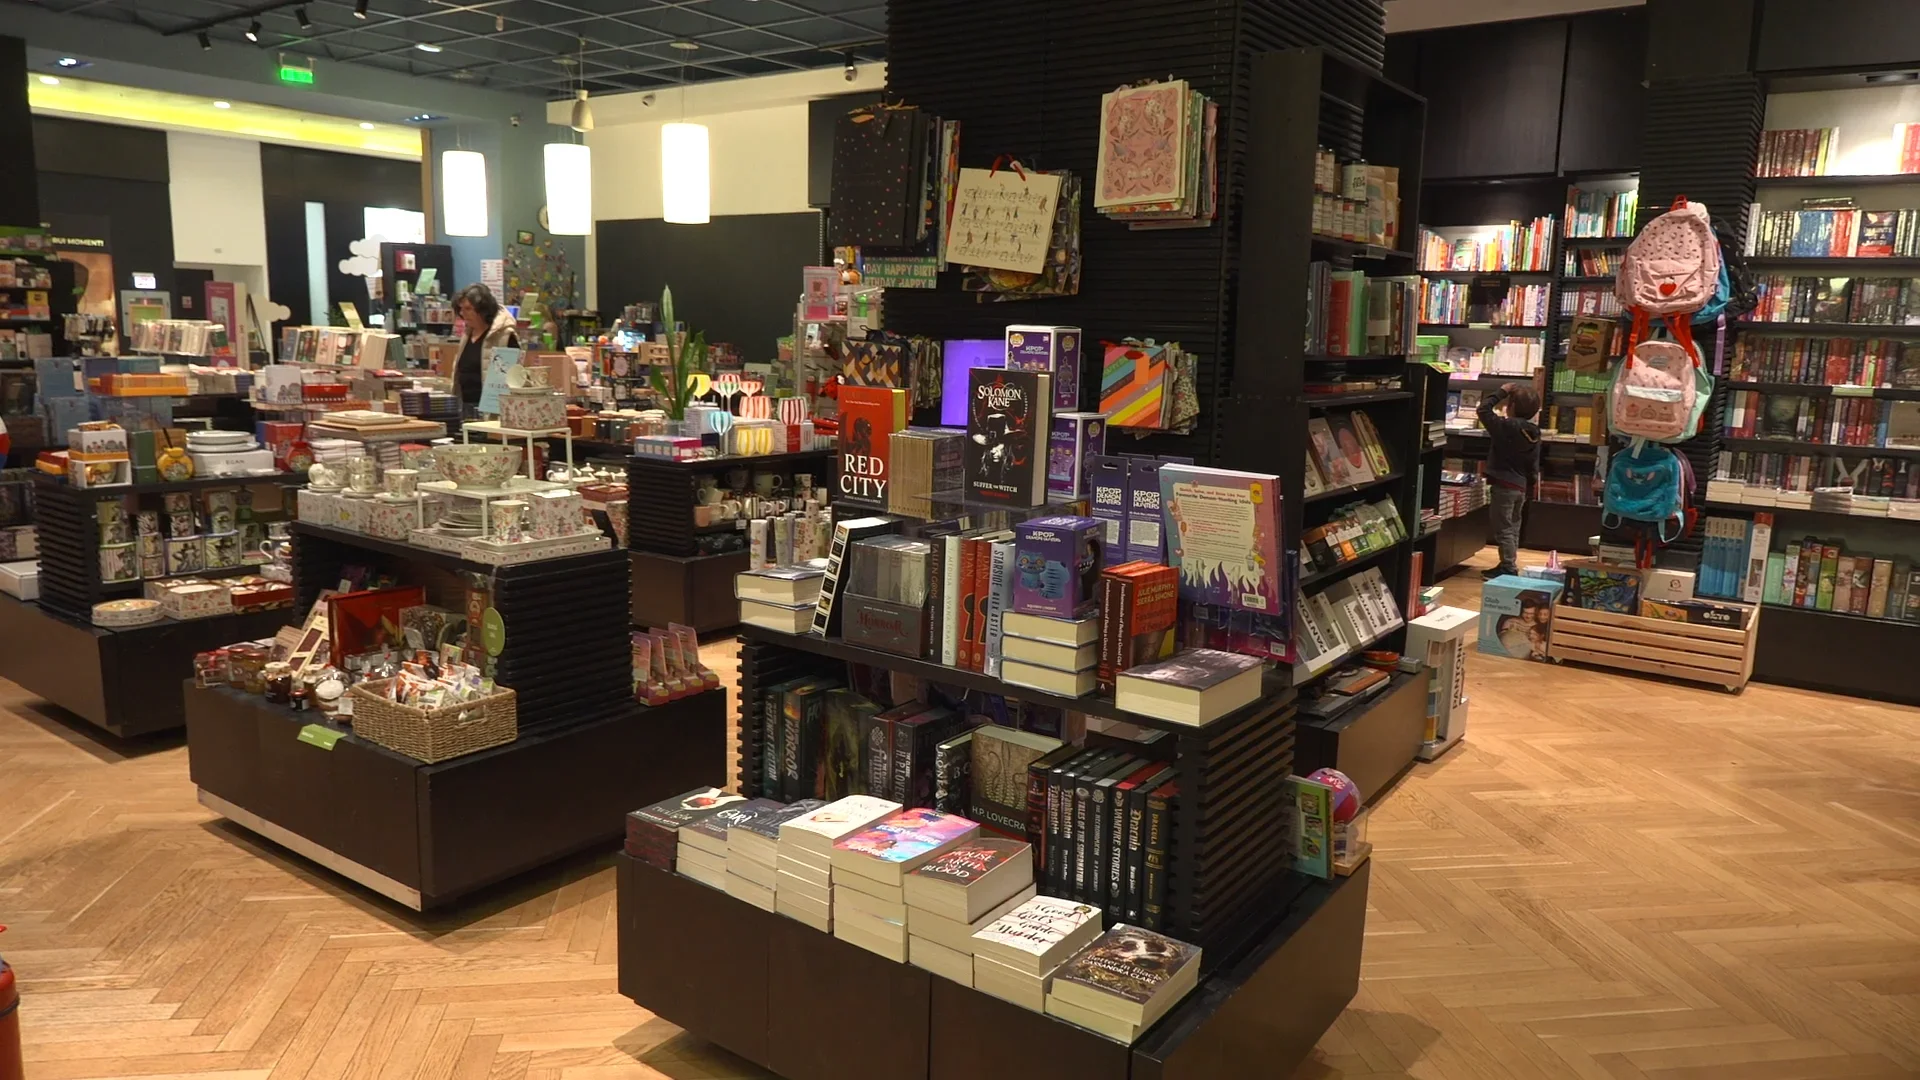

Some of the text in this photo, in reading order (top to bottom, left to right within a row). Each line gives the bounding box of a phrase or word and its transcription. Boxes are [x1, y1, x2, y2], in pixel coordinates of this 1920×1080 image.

[885, 264, 912, 276] HAPPY
[978, 385, 1022, 400] SOLOMON
[987, 398, 1010, 408] KANE
[844, 453, 884, 477] RED
[840, 474, 887, 499] CITY
[973, 480, 993, 490] SUFFER
[998, 484, 1018, 493] WITCH
[1096, 486, 1122, 494] KPOP
[1096, 492, 1122, 500] DEMON
[1133, 489, 1160, 498] KPOP
[1096, 498, 1122, 506] HUNTERS
[1133, 496, 1160, 504] DEMON
[1133, 502, 1160, 510] HUNTERS
[1032, 530, 1055, 538] KPOP
[931, 543, 939, 576] FALLEN
[966, 552, 974, 578] DAN
[975, 545, 983, 588] BROWN
[982, 554, 990, 580] DAN
[990, 549, 1004, 638] STARSIDE ALEX ASTER
[765, 700, 778, 781] SCIENCE FICTION
[784, 718, 799, 781] HORROR
[972, 805, 1026, 832] H.P. LOVECRA
[1050, 784, 1061, 835] Frankenstein
[1063, 788, 1074, 839] Frankenstein
[1128, 808, 1143, 852] Dracula
[1150, 813, 1159, 845] DRACULA
[949, 850, 995, 863] HOUSE
[1075, 800, 1086, 890] TALES OF THE SUPERNATURAL
[1111, 808, 1123, 882] VAMPIRE STORIES
[921, 864, 970, 878] BLOOD
[1041, 905, 1077, 918] Good
[997, 924, 1047, 944] Murder
[1082, 959, 1157, 985] CASSANDRA CLARE
[1087, 954, 1162, 981] Better in Black
